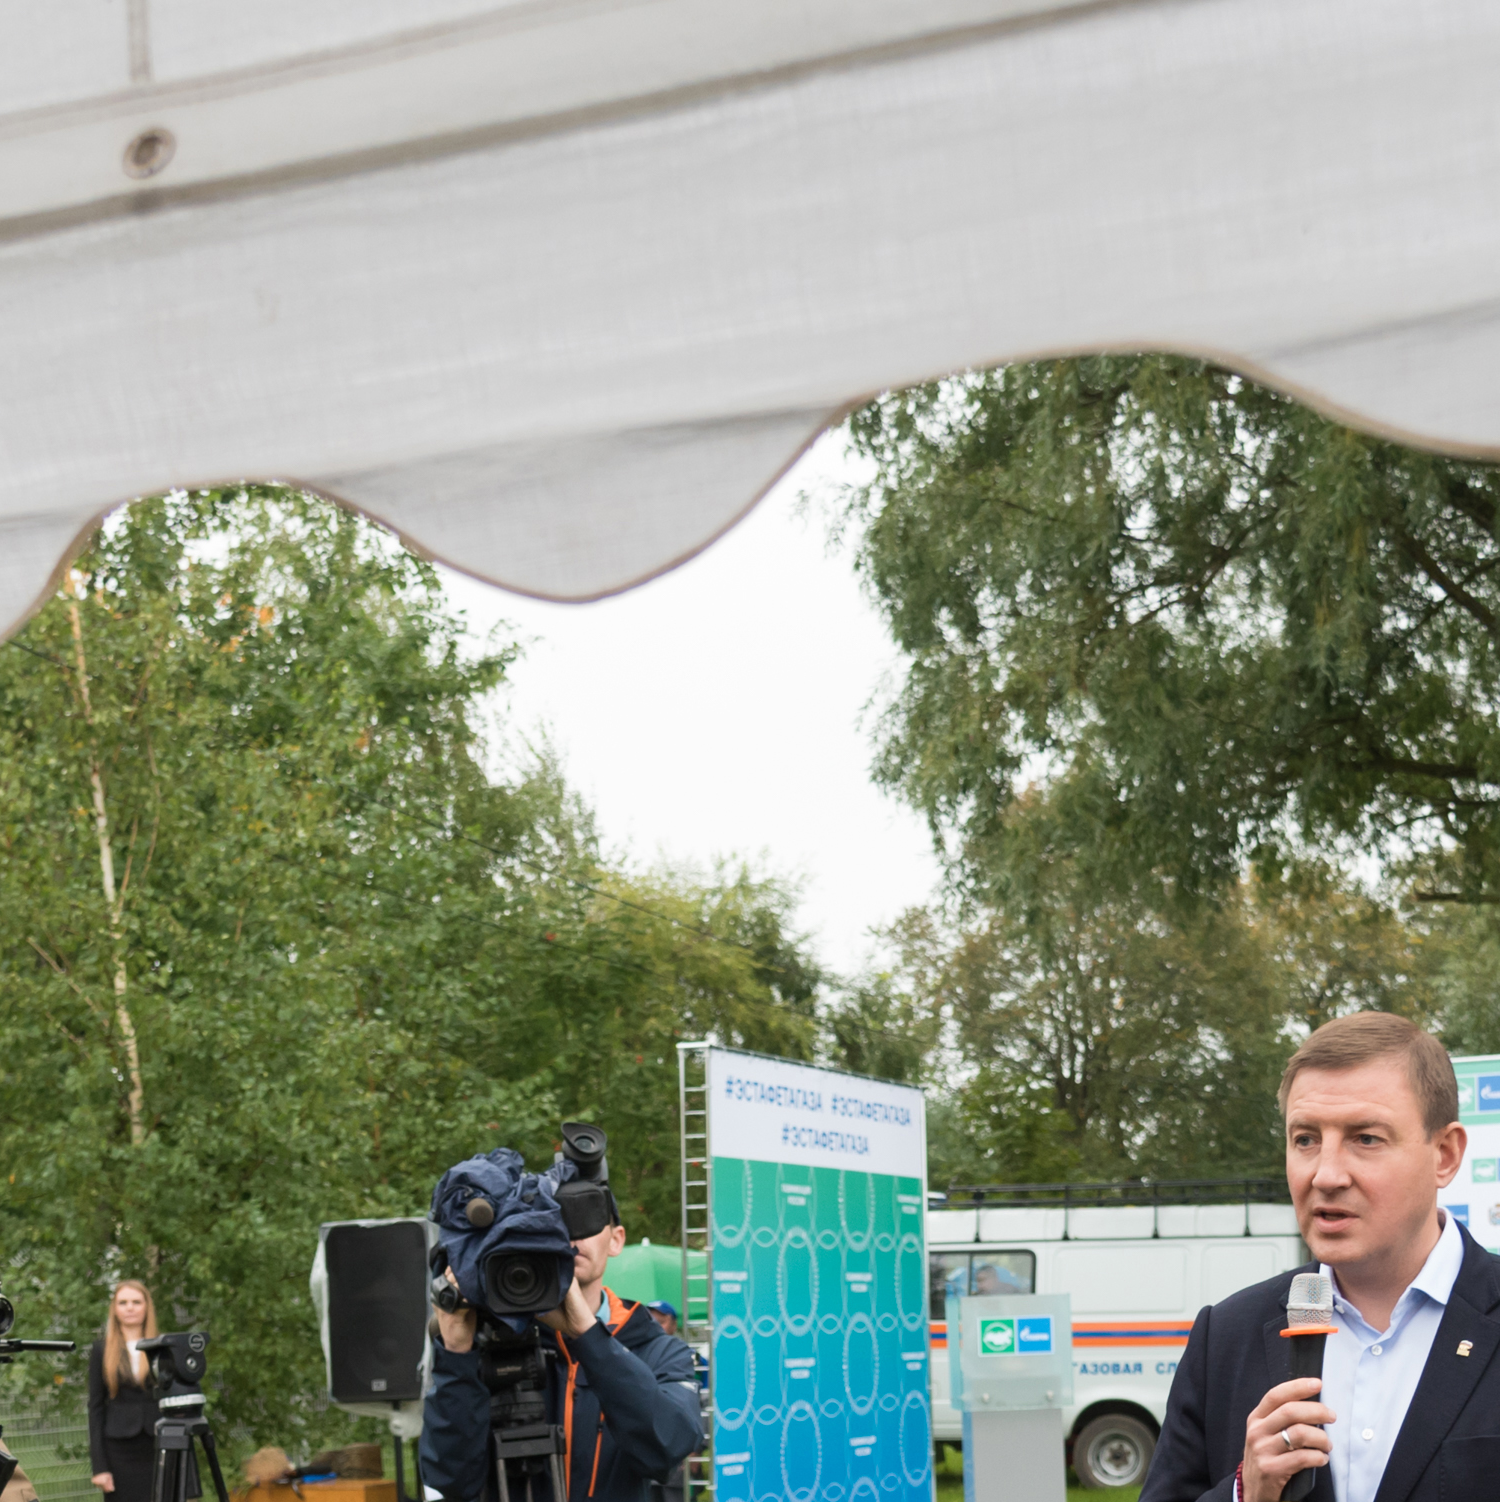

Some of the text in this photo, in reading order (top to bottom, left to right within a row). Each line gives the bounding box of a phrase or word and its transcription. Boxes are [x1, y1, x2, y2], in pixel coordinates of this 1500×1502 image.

[725, 1075, 911, 1126] #ЭСТАФЕТАГАЗА #ЭСТАФЕТАГАЗА
[781, 1124, 869, 1155] #ЭСТАФЕТАГАЗА
